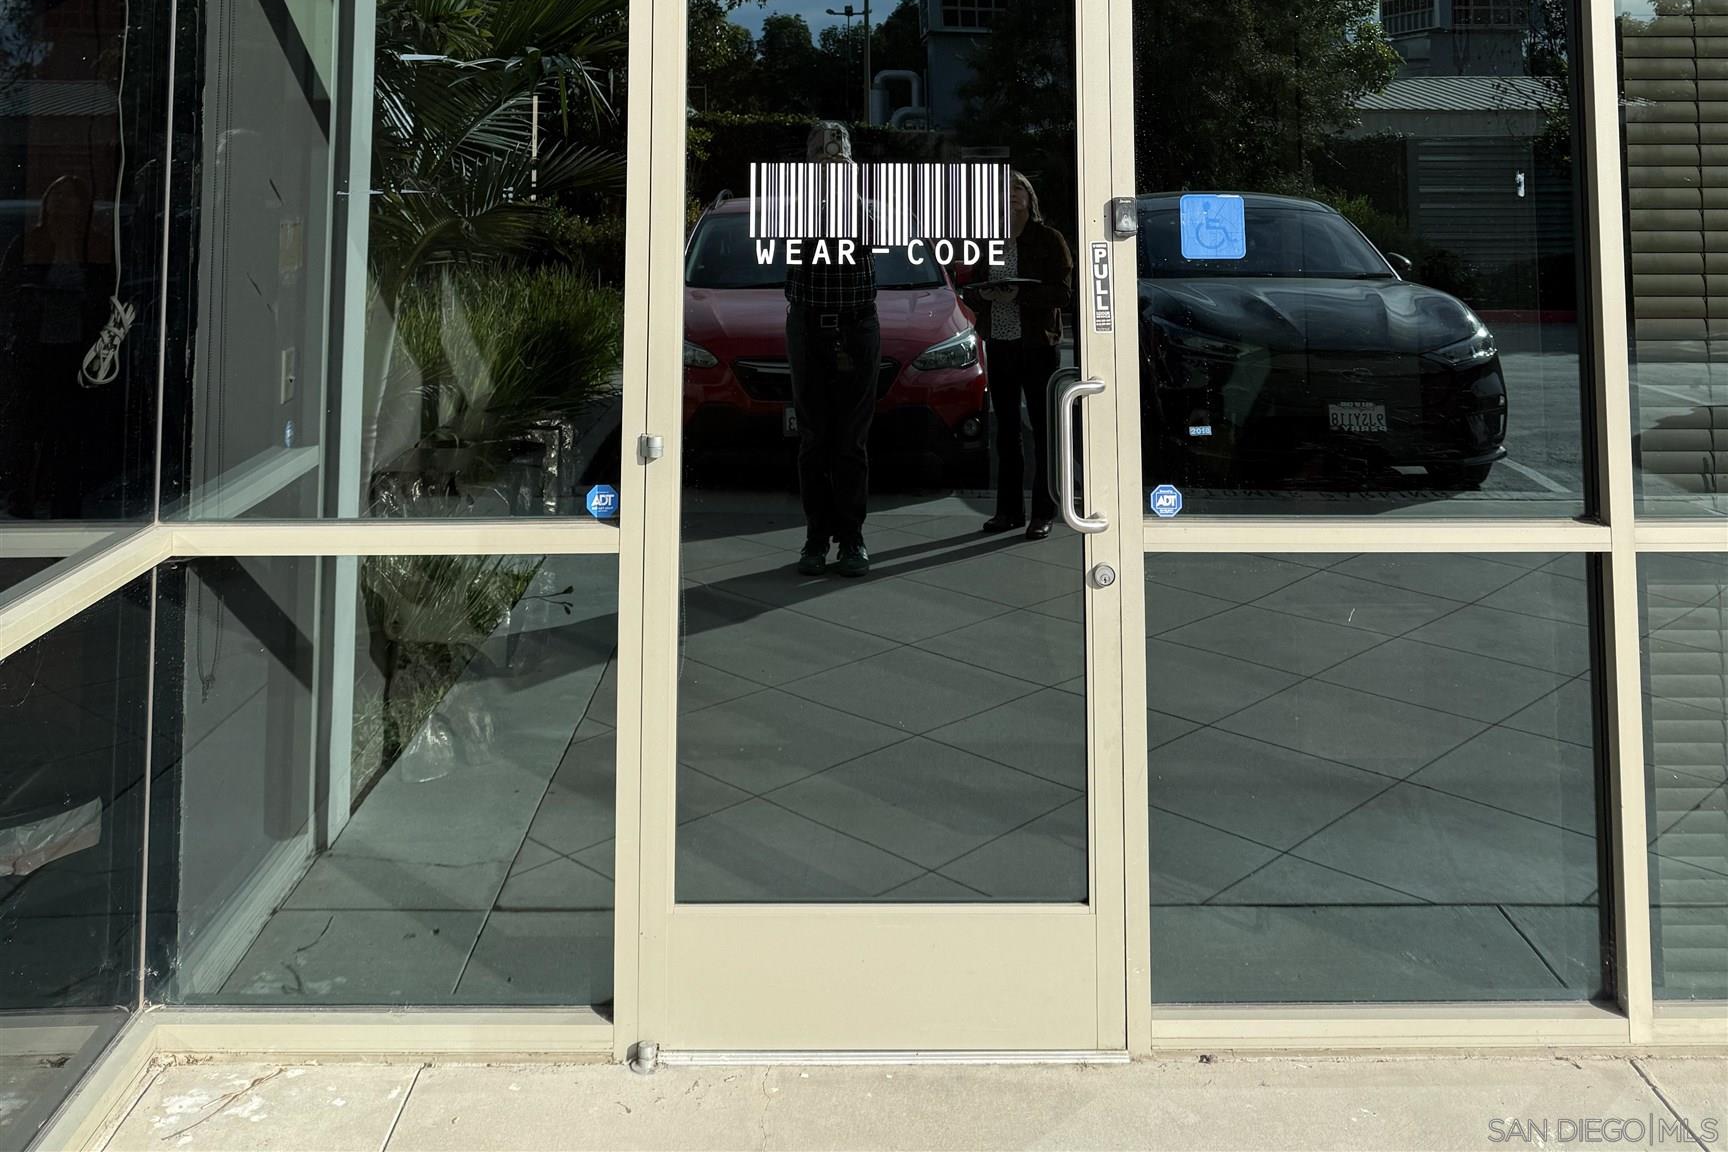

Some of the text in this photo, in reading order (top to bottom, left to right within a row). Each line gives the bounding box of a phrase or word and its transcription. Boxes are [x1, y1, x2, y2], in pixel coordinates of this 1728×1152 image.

[1094, 249, 1109, 311] PULL
[591, 494, 615, 506] ADT
[1156, 494, 1177, 507] ADT
